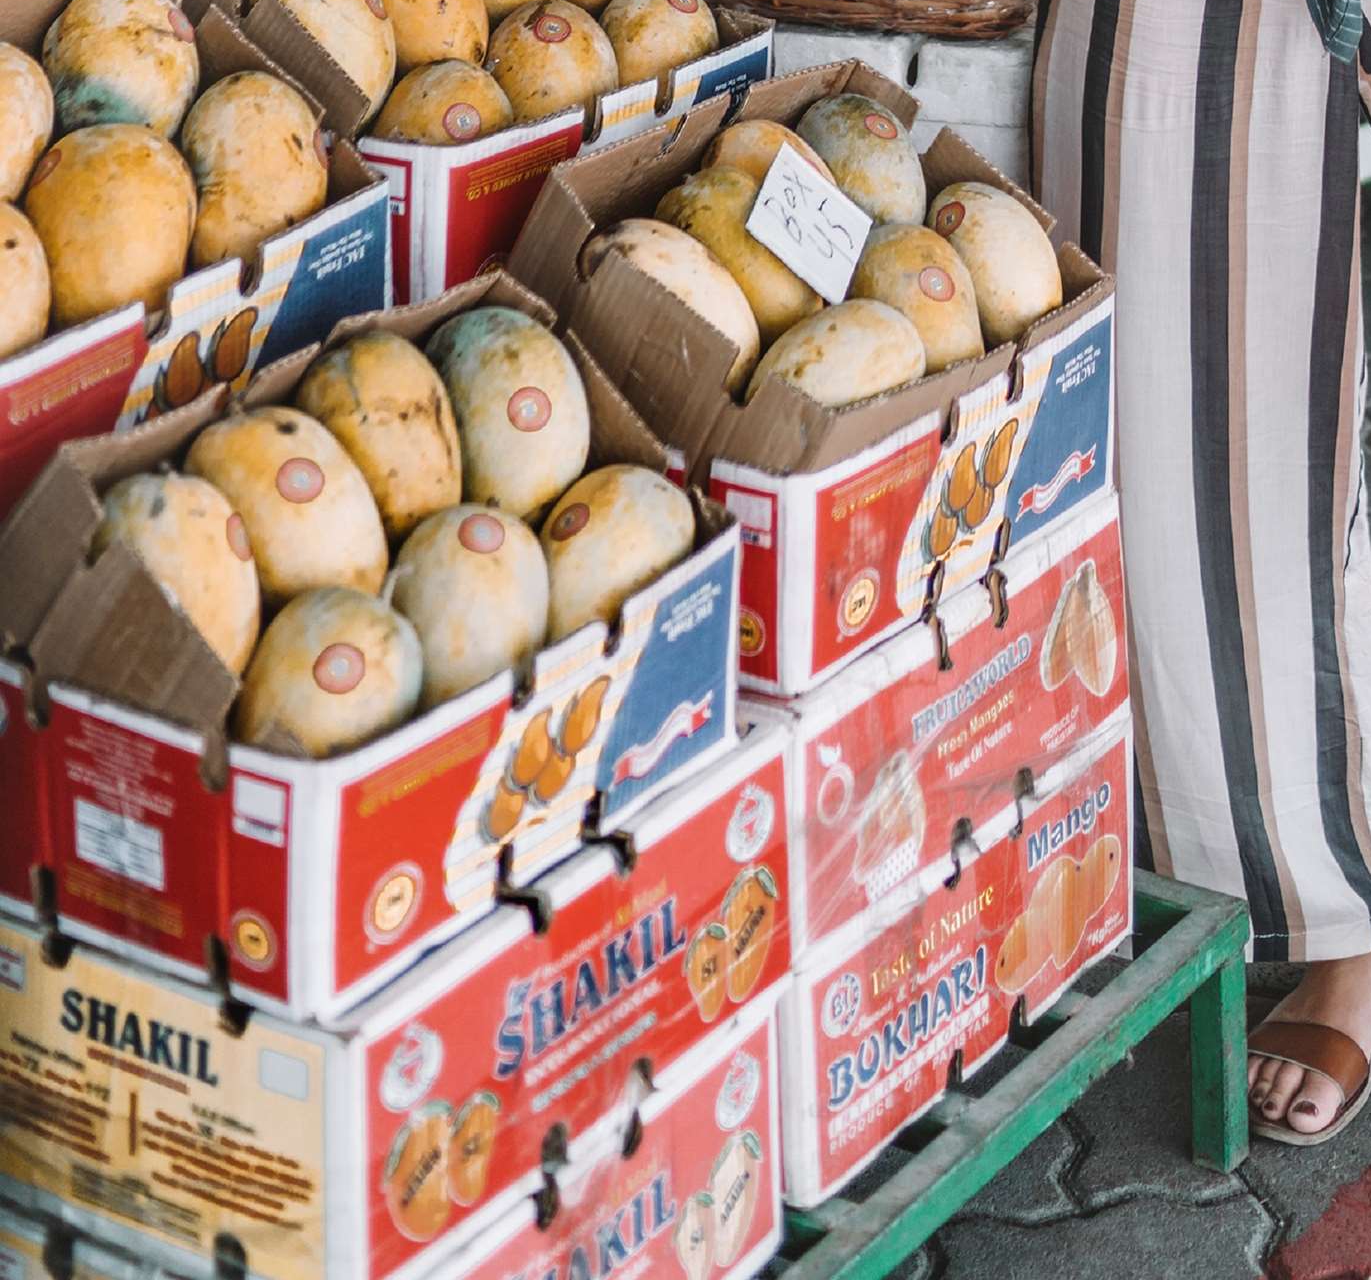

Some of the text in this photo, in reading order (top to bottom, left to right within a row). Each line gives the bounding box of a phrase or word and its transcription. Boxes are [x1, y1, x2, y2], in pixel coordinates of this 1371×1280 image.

[1027, 782, 1111, 872] Mango
[918, 921, 937, 960] of
[940, 885, 995, 942] Nature
[496, 896, 687, 1078] SHAKIL
[828, 945, 986, 1112] BOKHARI
[60, 987, 219, 1088] SHAKIL
[904, 1071, 922, 1092] OF
